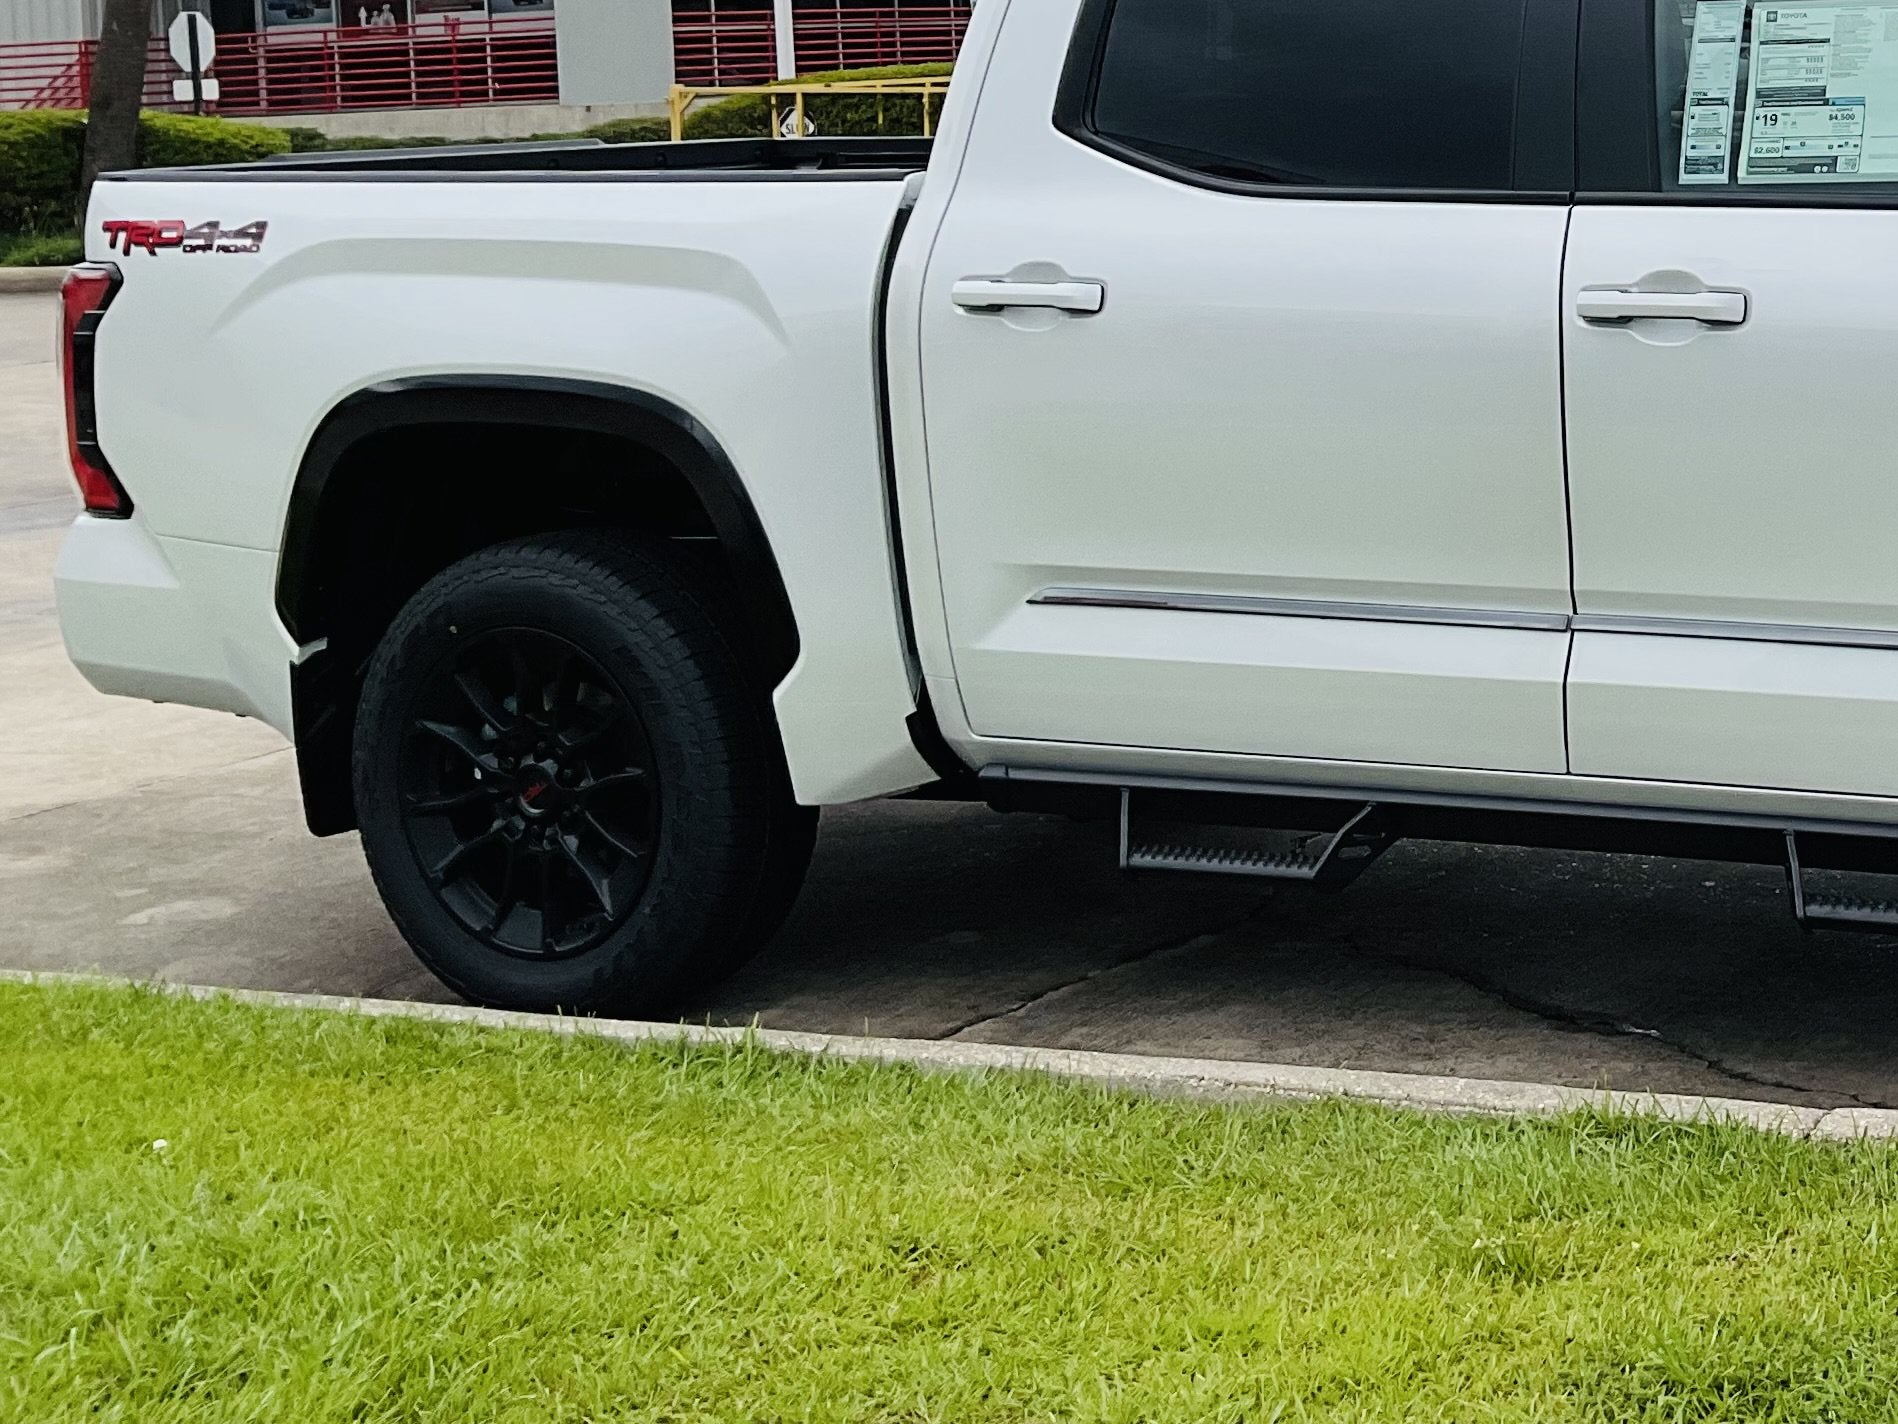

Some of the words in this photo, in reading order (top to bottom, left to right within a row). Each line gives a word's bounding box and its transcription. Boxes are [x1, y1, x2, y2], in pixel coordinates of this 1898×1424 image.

[1761, 113, 1778, 126] 19
[102, 220, 186, 256] TRD
[182, 243, 214, 254] OFF
[215, 243, 260, 254] ROAD
